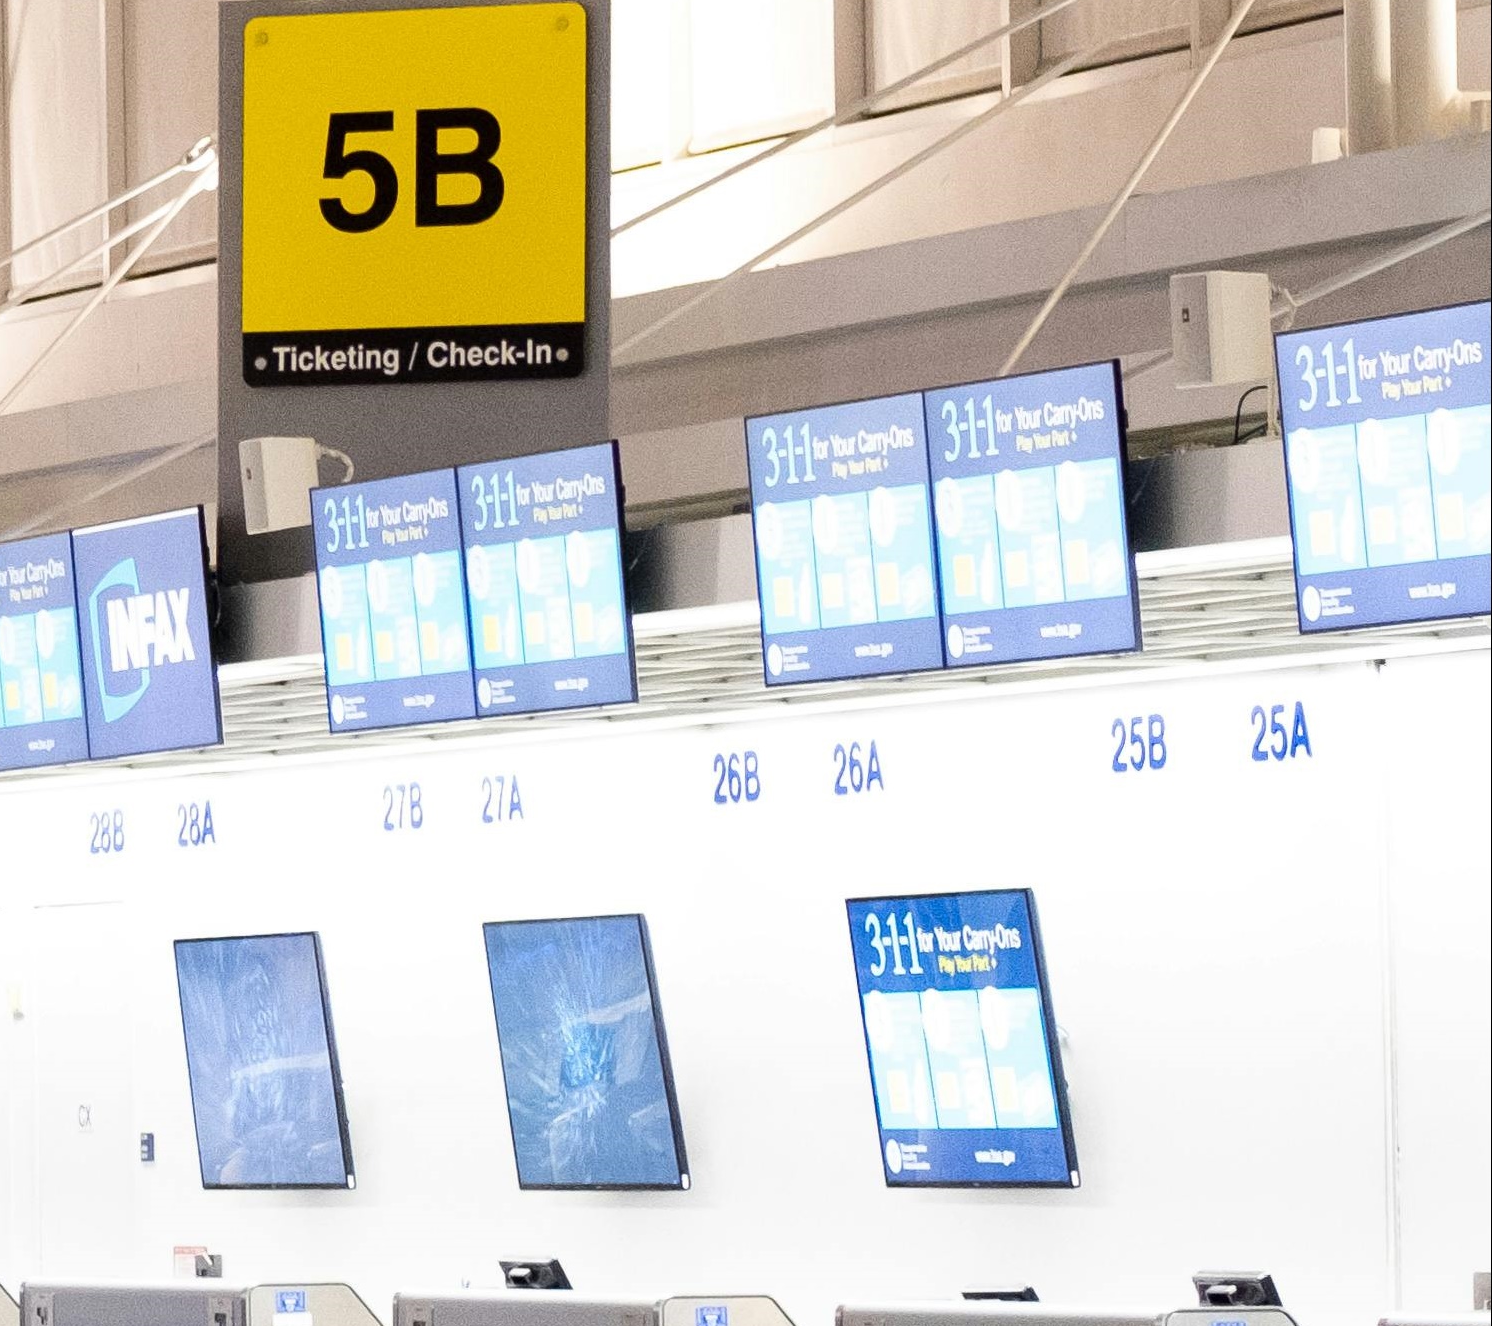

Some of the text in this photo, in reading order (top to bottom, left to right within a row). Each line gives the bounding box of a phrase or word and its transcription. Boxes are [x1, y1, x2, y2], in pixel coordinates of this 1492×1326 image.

[319, 107, 505, 234] 5B
[272, 339, 552, 375] Ticketing / Check-In
[1295, 338, 1483, 412] 3-1-1 for Your Carry-Ons
[761, 422, 914, 487] 3-1-1 for Your Carry-Ons
[941, 394, 1104, 463] 3-1-1 for Your Carry-Ons
[325, 494, 369, 552] 3-1-1
[380, 505, 402, 525] Your
[471, 470, 520, 531] 3-1-1
[532, 481, 555, 503] Your
[106, 587, 196, 672] INFAX
[1111, 712, 1168, 773] 25B
[1250, 701, 1313, 762] 25A
[712, 749, 762, 805] 26B
[833, 739, 885, 796] 26A
[177, 800, 216, 847] 28A
[383, 781, 424, 831] 27B
[481, 775, 524, 824] 27A
[89, 809, 125, 854] 28B
[865, 912, 1021, 977] 3-1-1 for Your Carry-Ons
